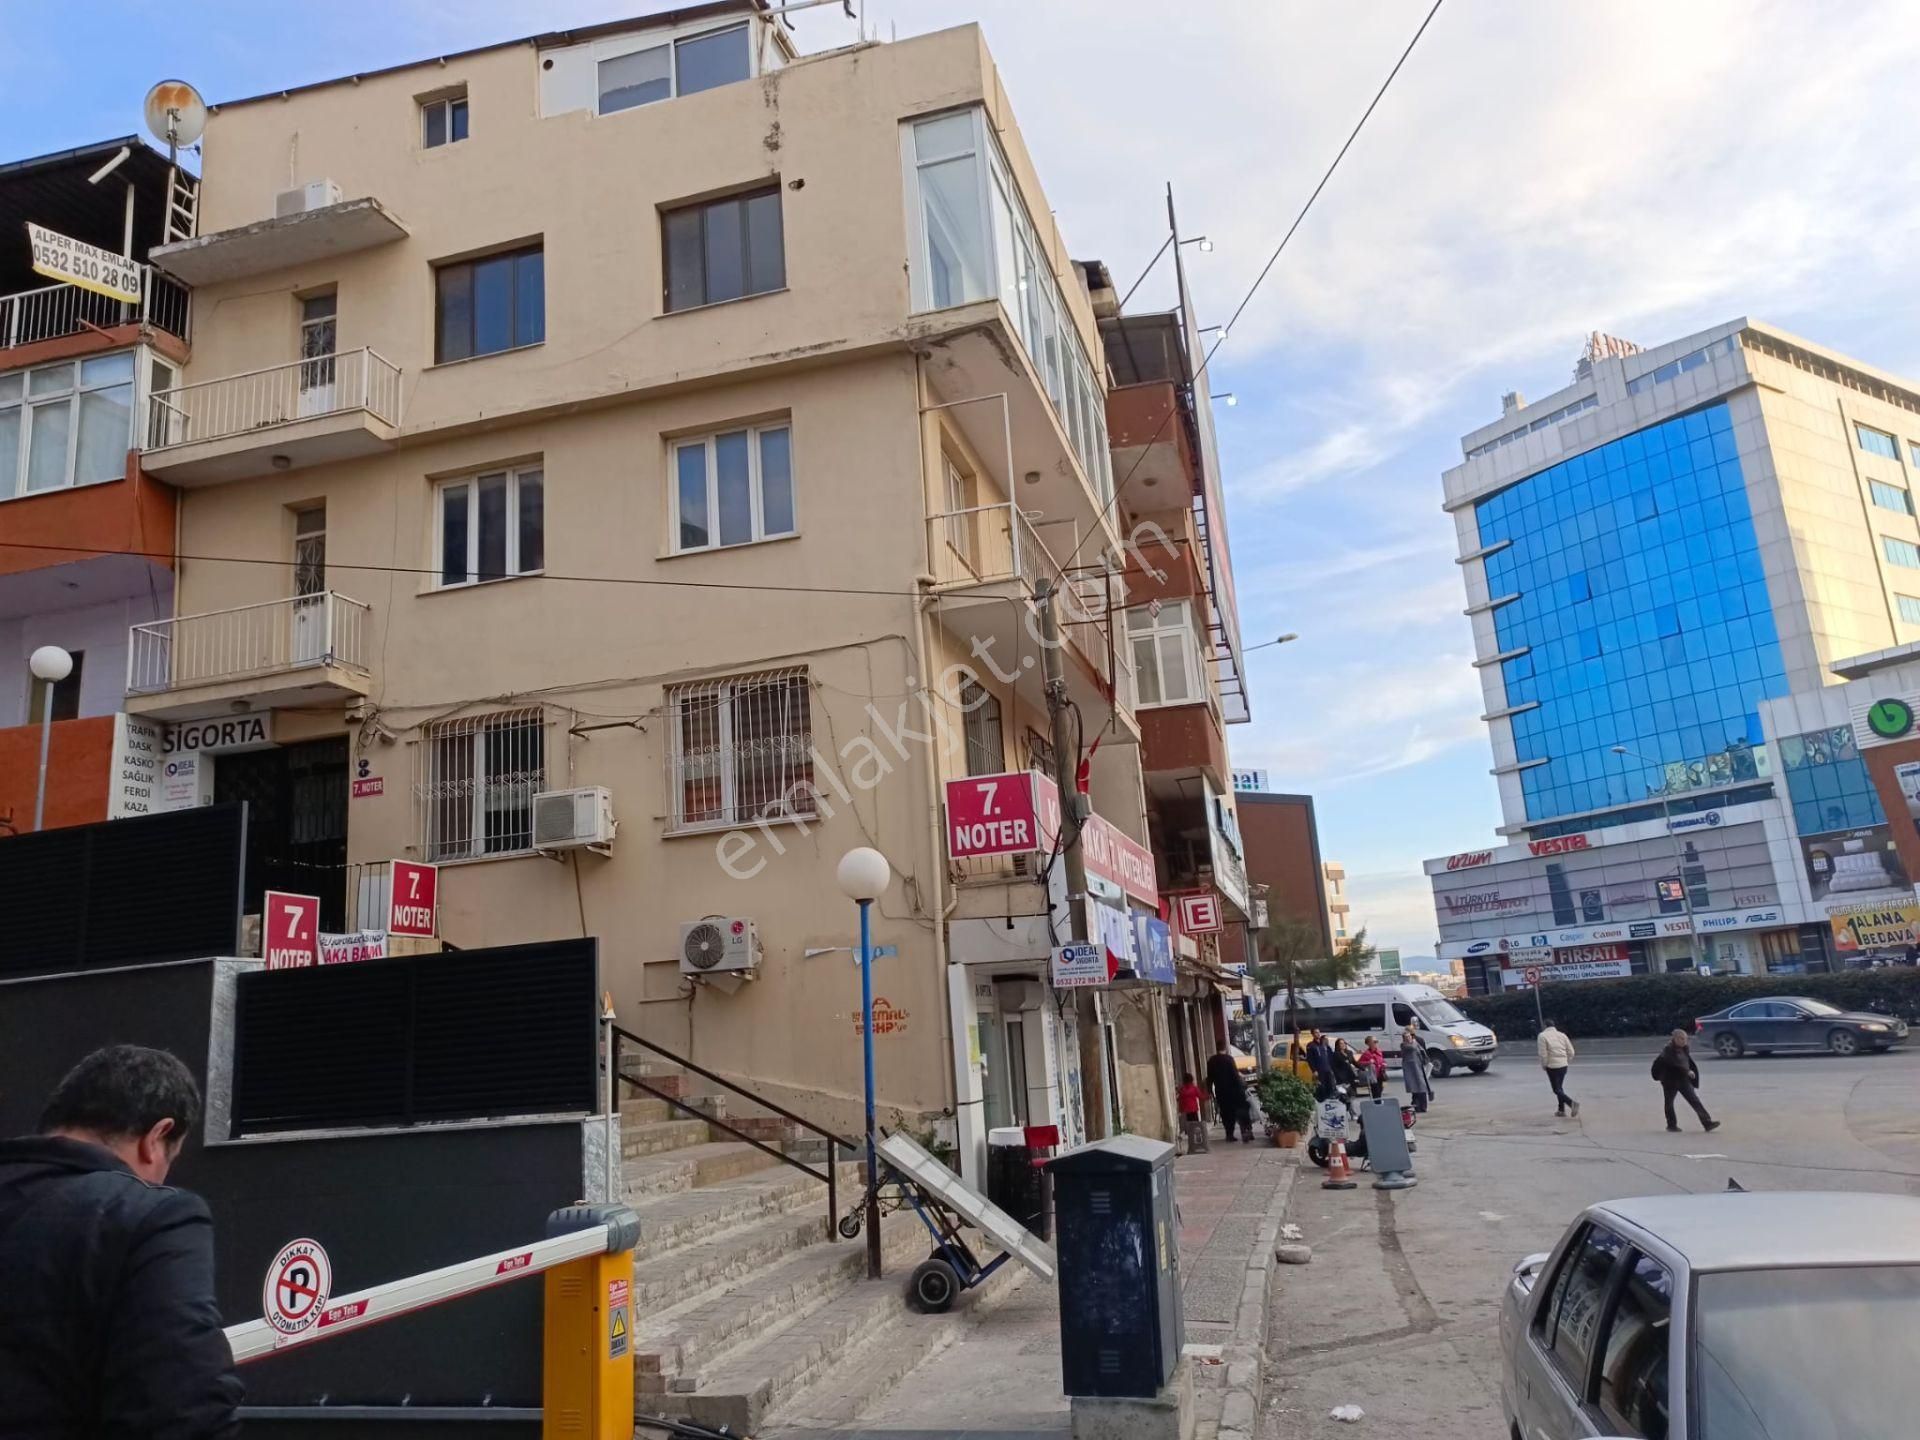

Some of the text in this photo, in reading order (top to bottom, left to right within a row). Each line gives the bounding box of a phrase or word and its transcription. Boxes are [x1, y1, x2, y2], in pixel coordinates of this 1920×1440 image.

[35, 230, 135, 273] ALPER MAX EMLAK
[33, 244, 138, 293] 0532 510 28 09
[129, 739, 152, 752] DASK
[162, 718, 266, 754] SİGORTA
[124, 755, 154, 769] KASKO
[122, 768, 154, 784] SAĞLIK
[124, 786, 151, 798] FERDİ
[976, 782, 1001, 816] 7.
[124, 801, 149, 813] KAZA
[956, 818, 1029, 850] NOTER
[1528, 834, 1592, 856] VESTEL
[408, 872, 420, 899] 7.
[284, 905, 308, 940] 7.
[394, 904, 431, 928] NOTER
[1702, 917, 1737, 927] PHILIPS
[1857, 911, 1905, 928] ALANA
[732, 937, 743, 945] LG
[1862, 929, 1916, 945] BEDAVA
[270, 948, 312, 970] NOTER
[1560, 946, 1617, 964] FIRSATI
[280, 1246, 315, 1267] DİKKAT
[310, 1294, 325, 1318] KAPI
